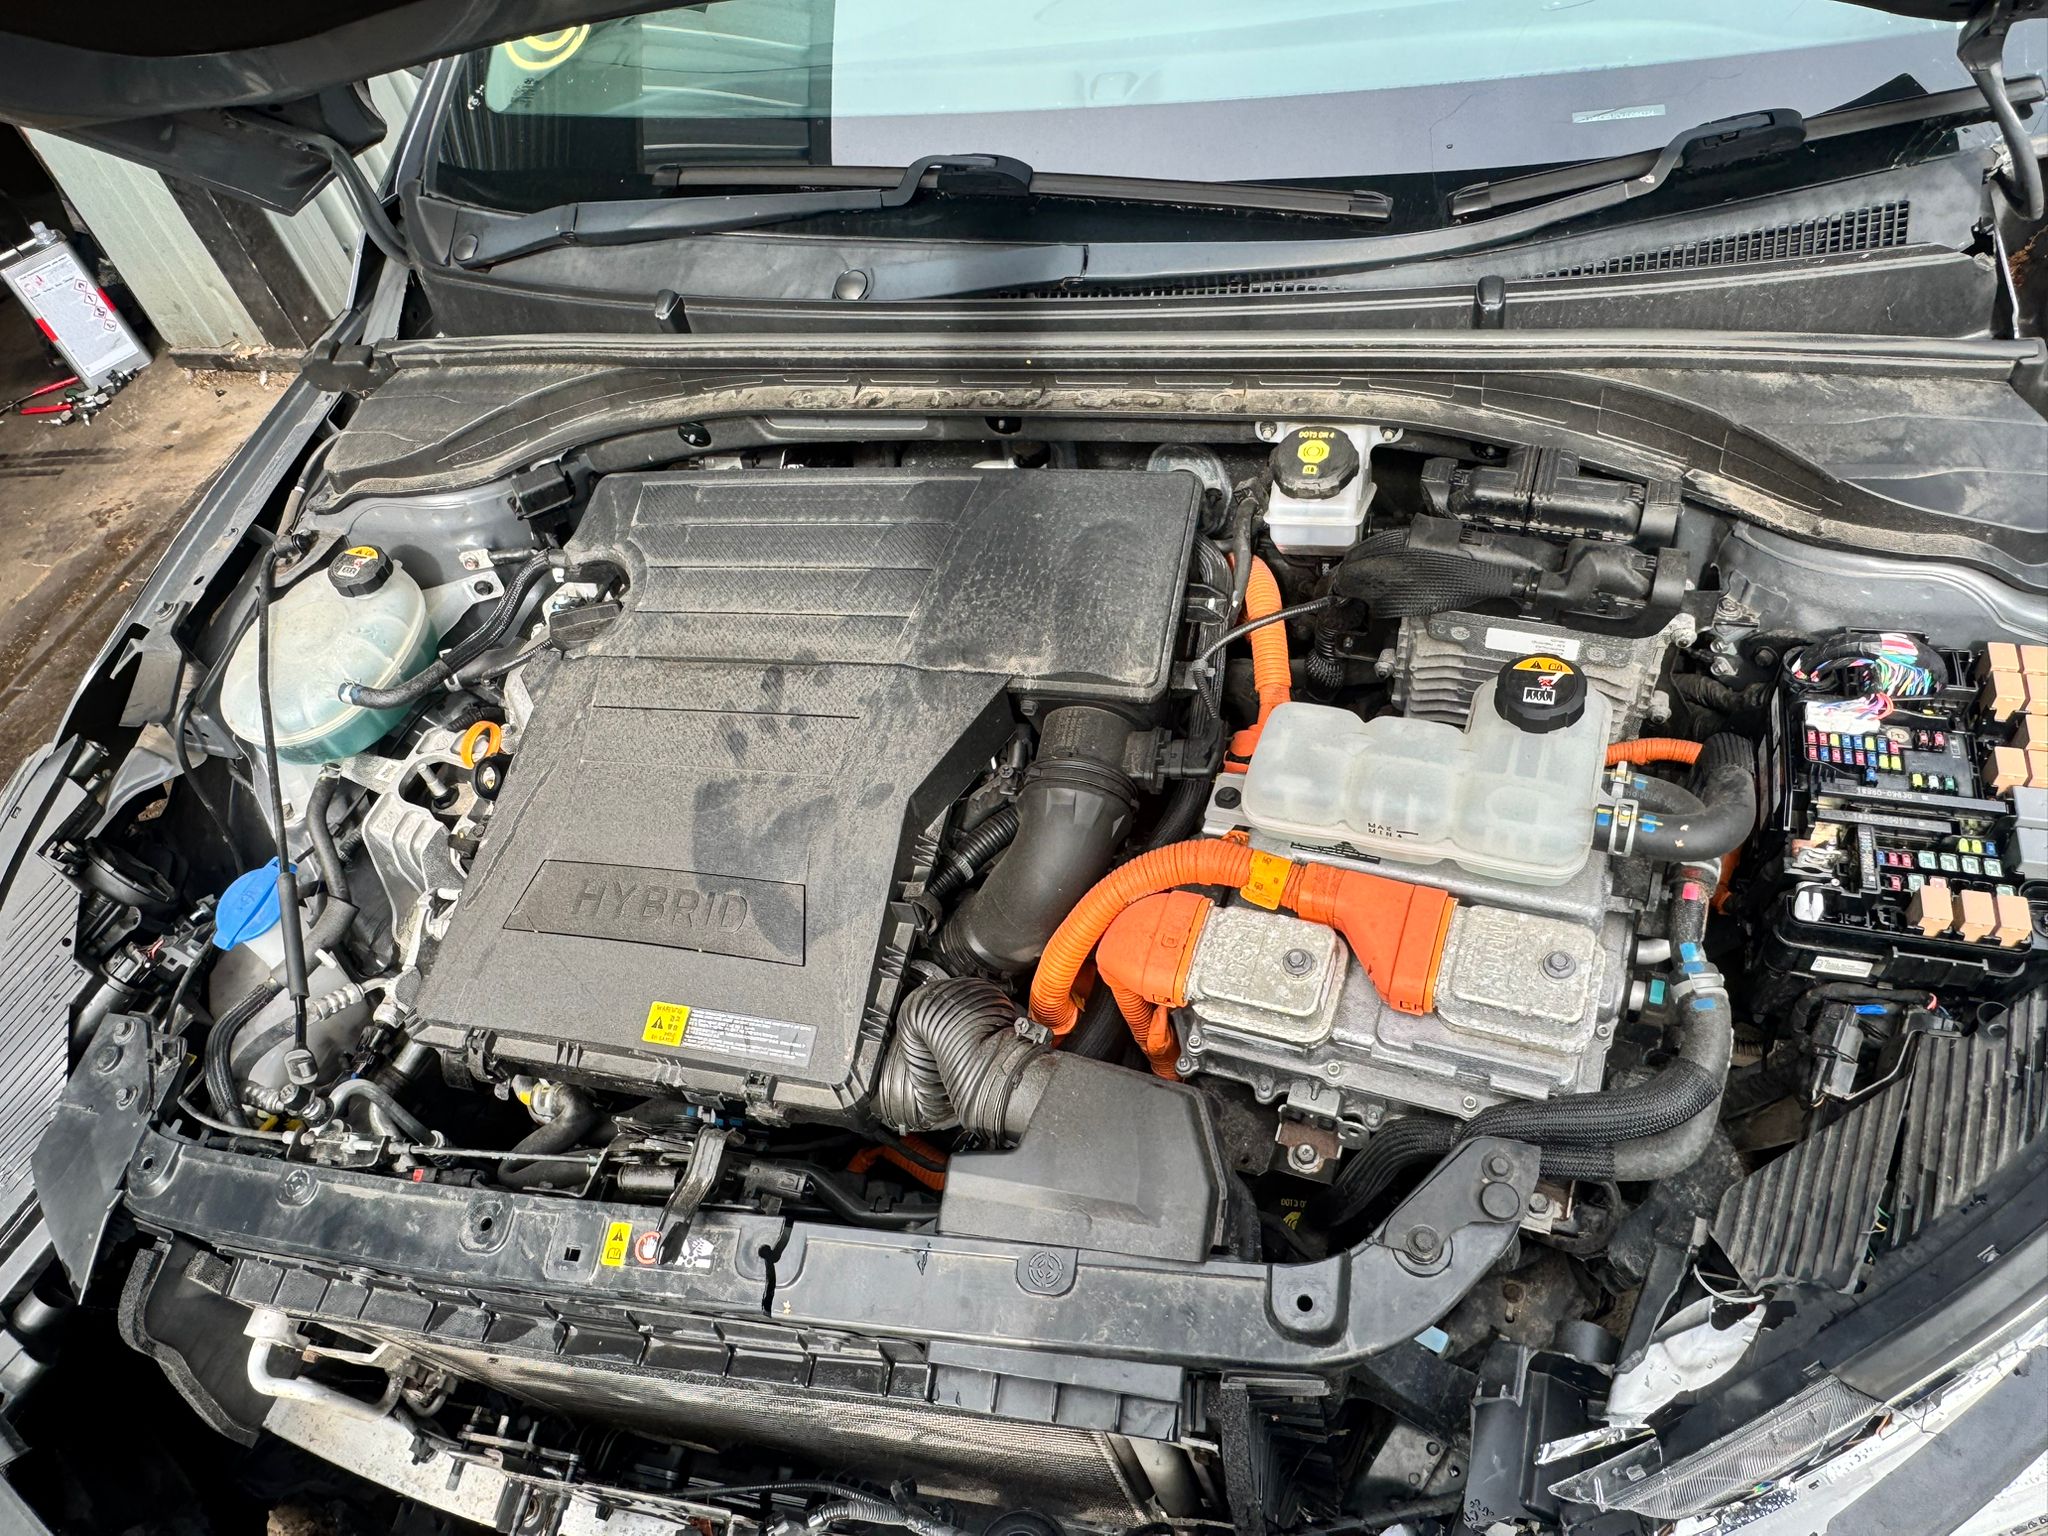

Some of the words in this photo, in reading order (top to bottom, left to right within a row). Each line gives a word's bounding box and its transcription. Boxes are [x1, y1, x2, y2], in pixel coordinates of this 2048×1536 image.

[1368, 822, 1392, 831] MAX
[1368, 828, 1392, 837] MIN
[571, 880, 748, 934] HYBRID
[1300, 1200, 1307, 1209] O
